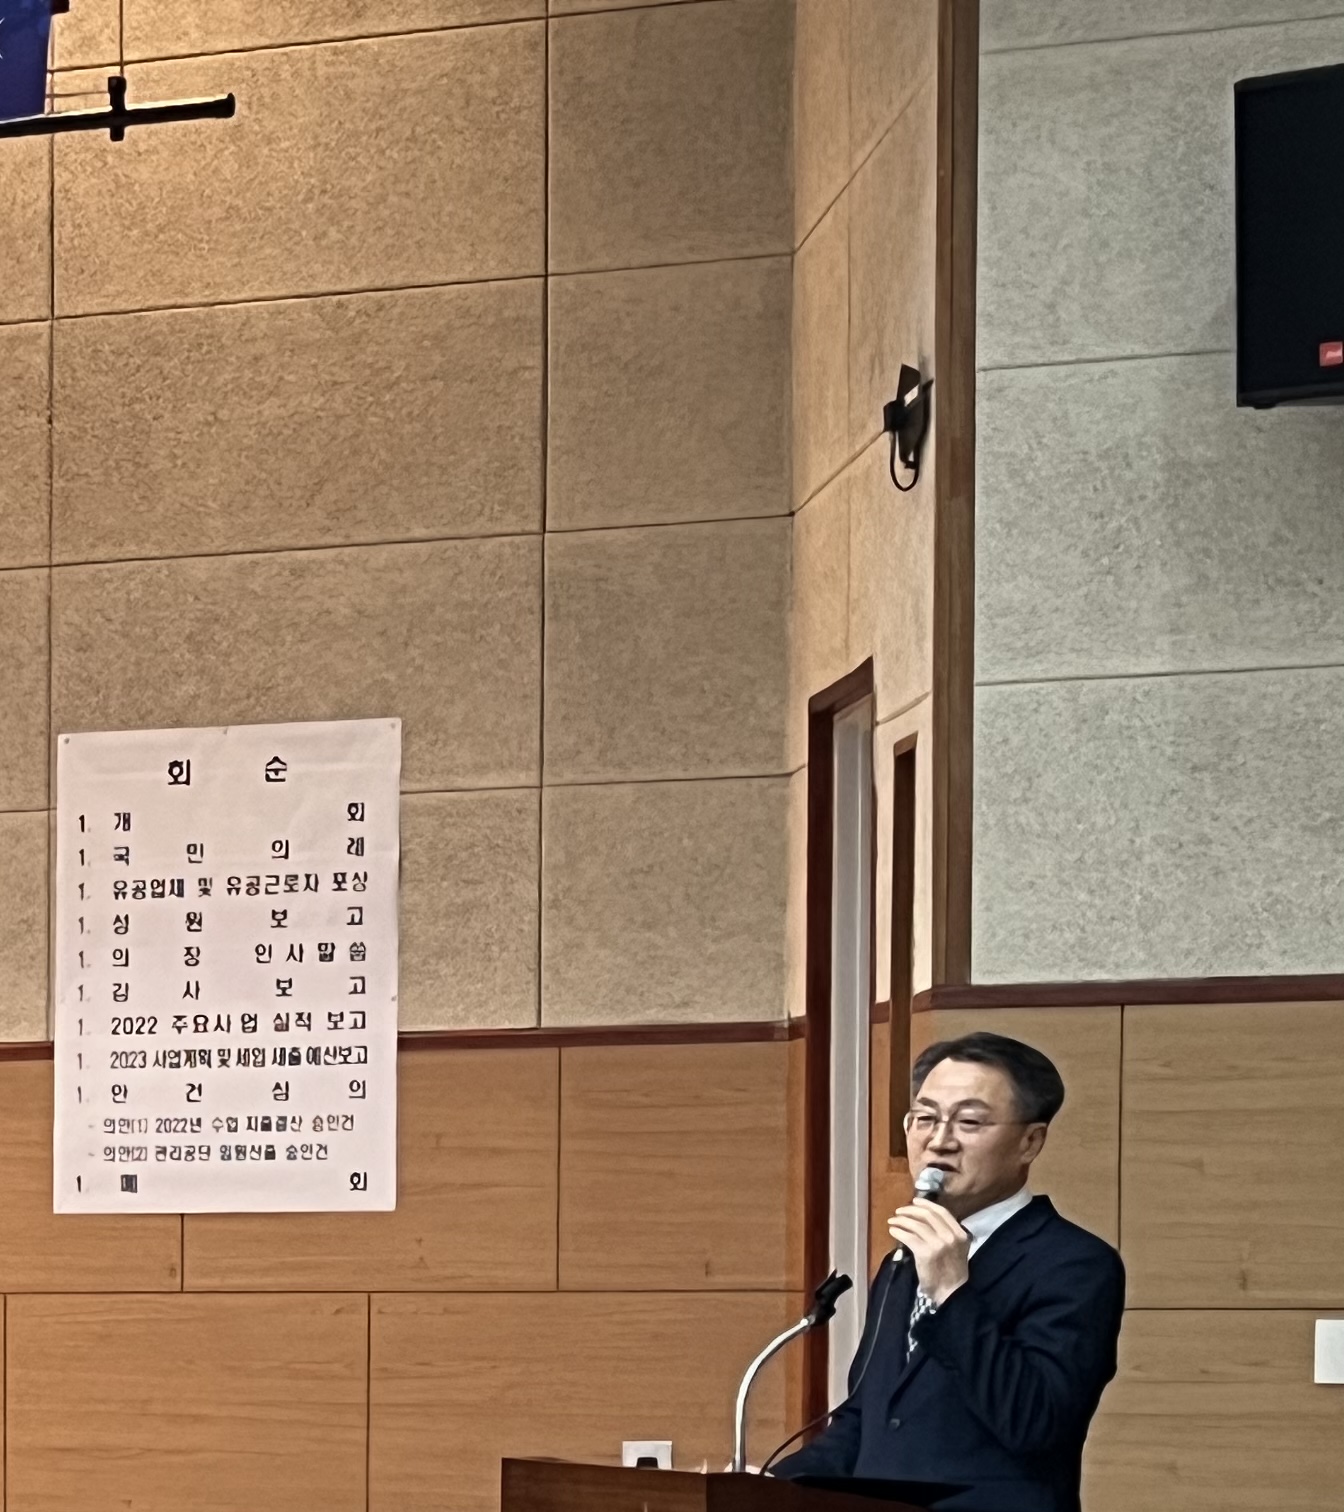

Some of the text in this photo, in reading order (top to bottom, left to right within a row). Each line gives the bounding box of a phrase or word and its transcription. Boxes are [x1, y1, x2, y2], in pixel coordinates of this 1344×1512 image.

[226, 872, 320, 897] 유공근로자
[331, 870, 369, 893] 포상
[110, 1015, 159, 1036] 2022
[272, 1011, 312, 1033] 실적
[326, 1010, 367, 1031] 보고
[109, 1049, 148, 1070] 2023
